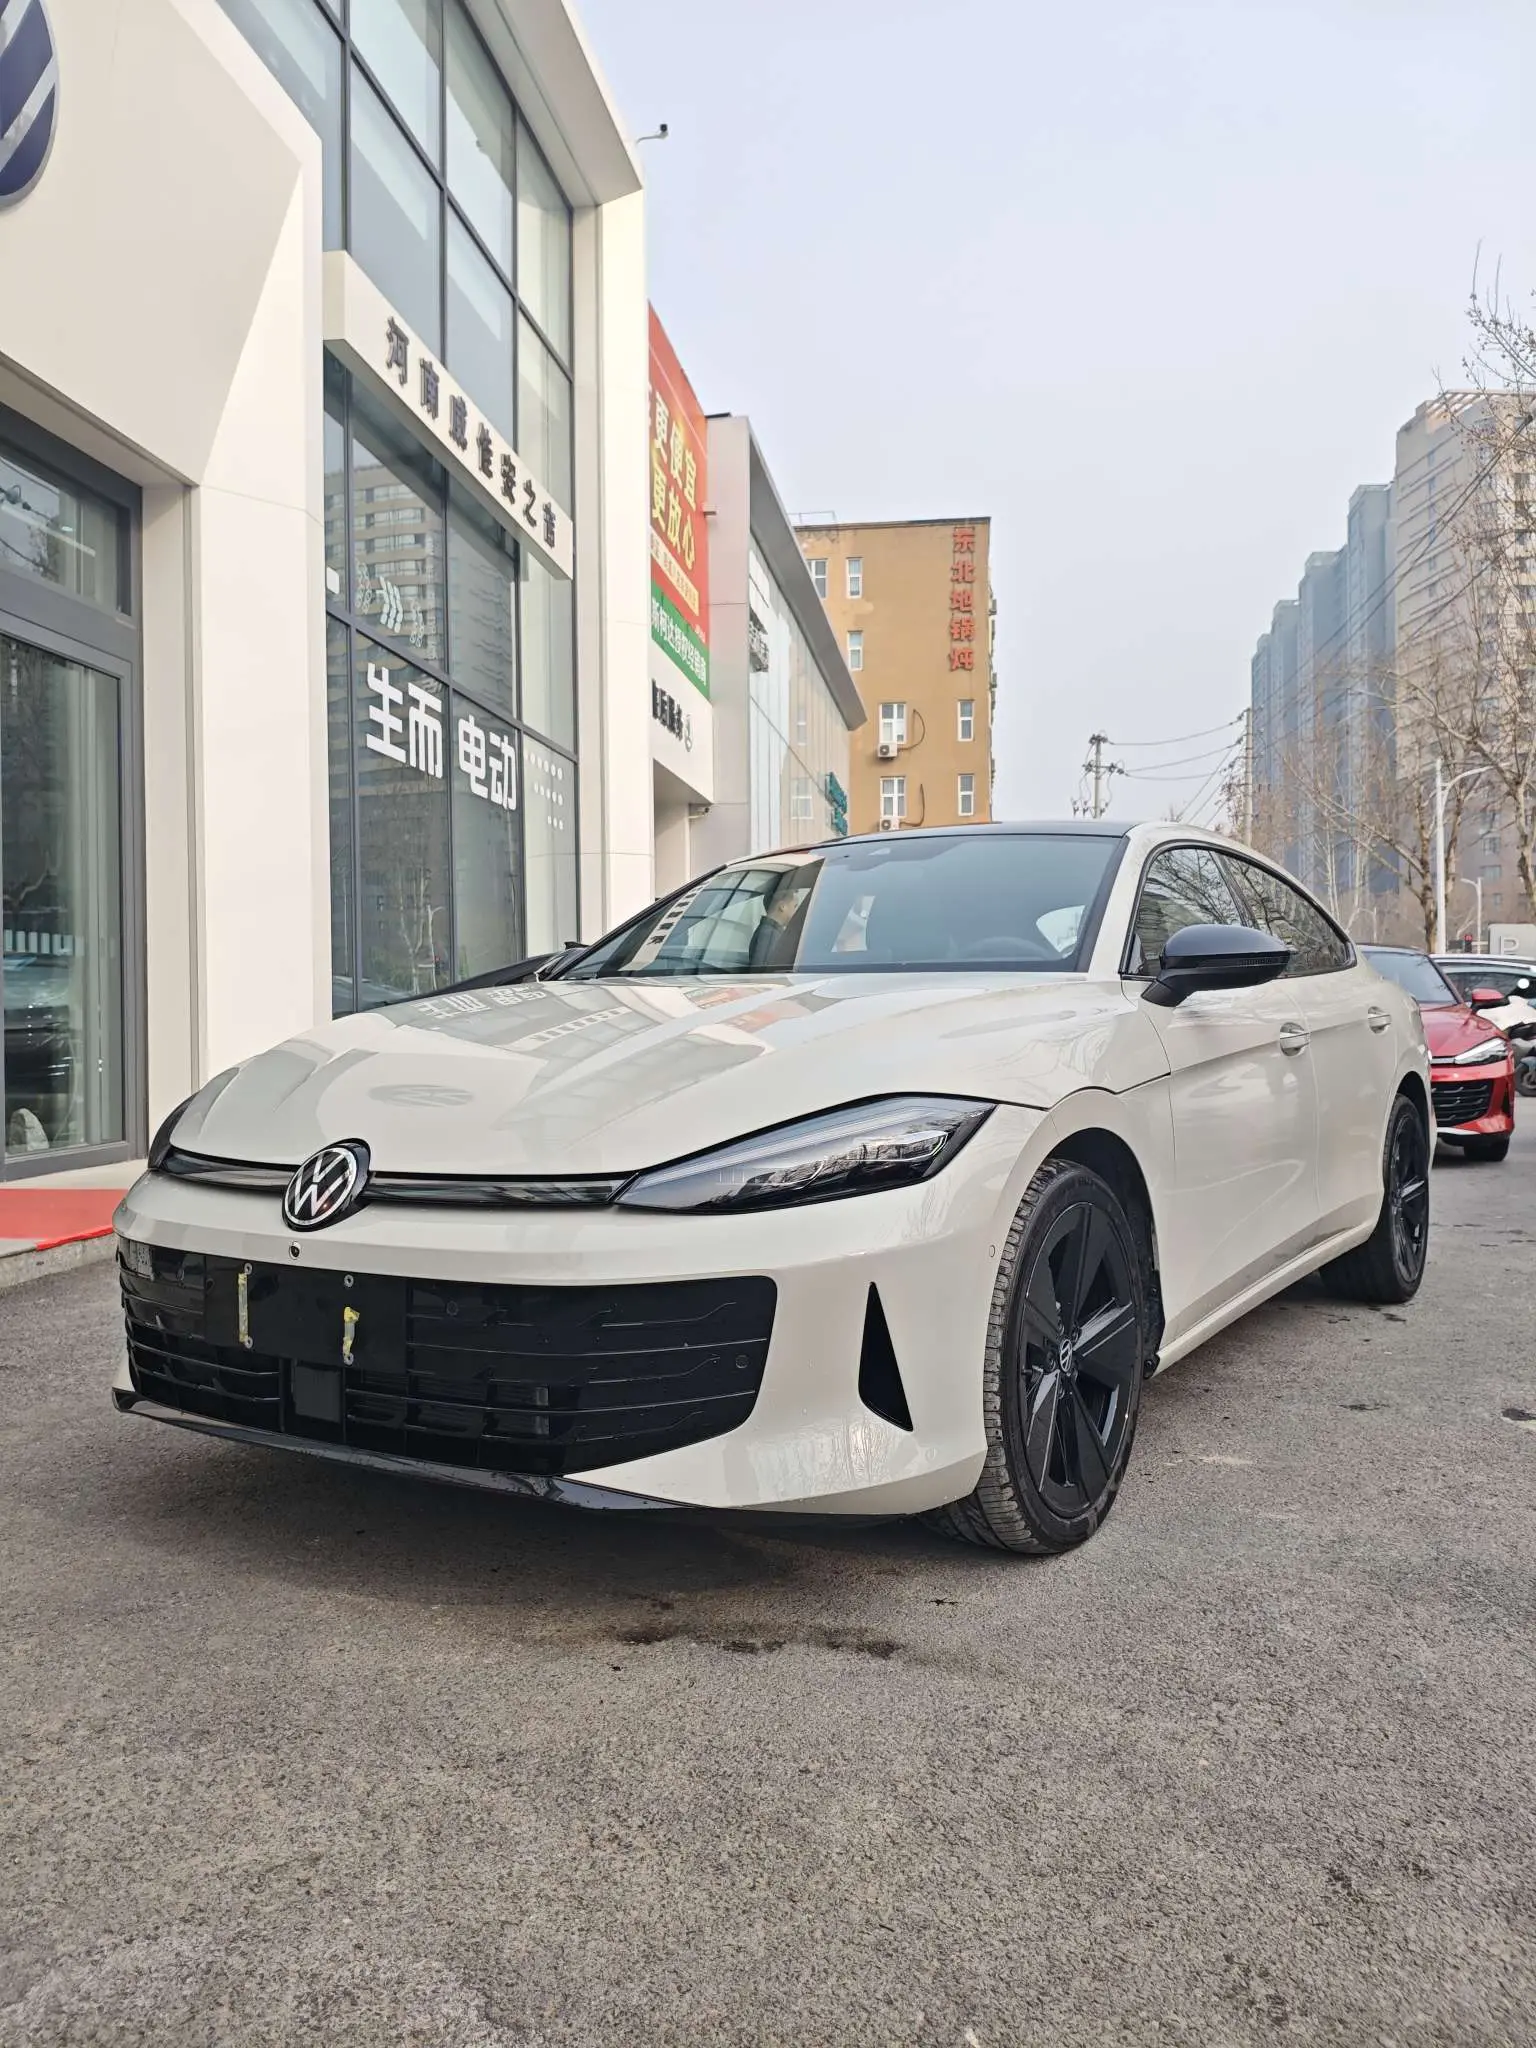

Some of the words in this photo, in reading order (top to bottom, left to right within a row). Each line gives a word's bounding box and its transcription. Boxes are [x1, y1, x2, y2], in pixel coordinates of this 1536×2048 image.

[649, 383, 697, 512] 更便宜
[652, 462, 695, 570] 更放心
[1500, 936, 1519, 956] P
